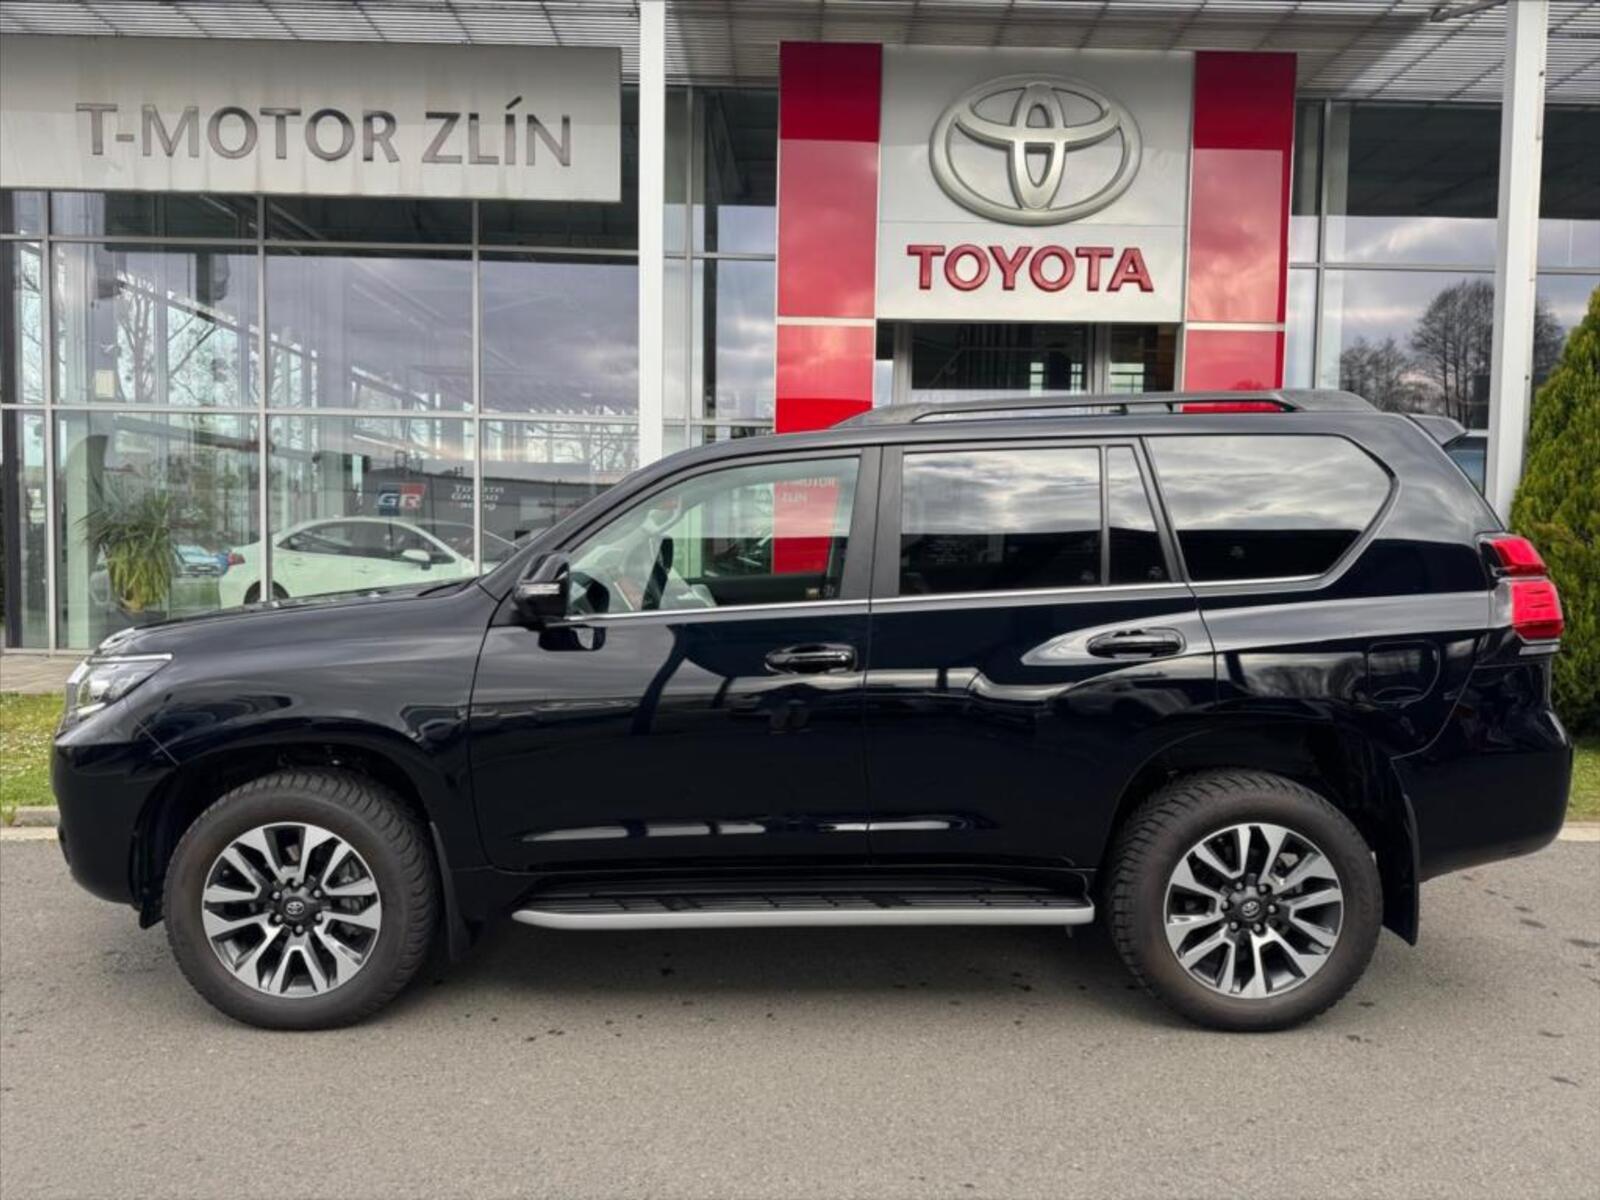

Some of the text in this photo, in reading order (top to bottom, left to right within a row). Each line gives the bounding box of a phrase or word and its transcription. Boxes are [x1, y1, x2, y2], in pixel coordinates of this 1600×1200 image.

[75, 96, 571, 167] T-MOTOR ZLÍN
[906, 243, 1155, 293] TOYOTA
[377, 491, 422, 511] GR
